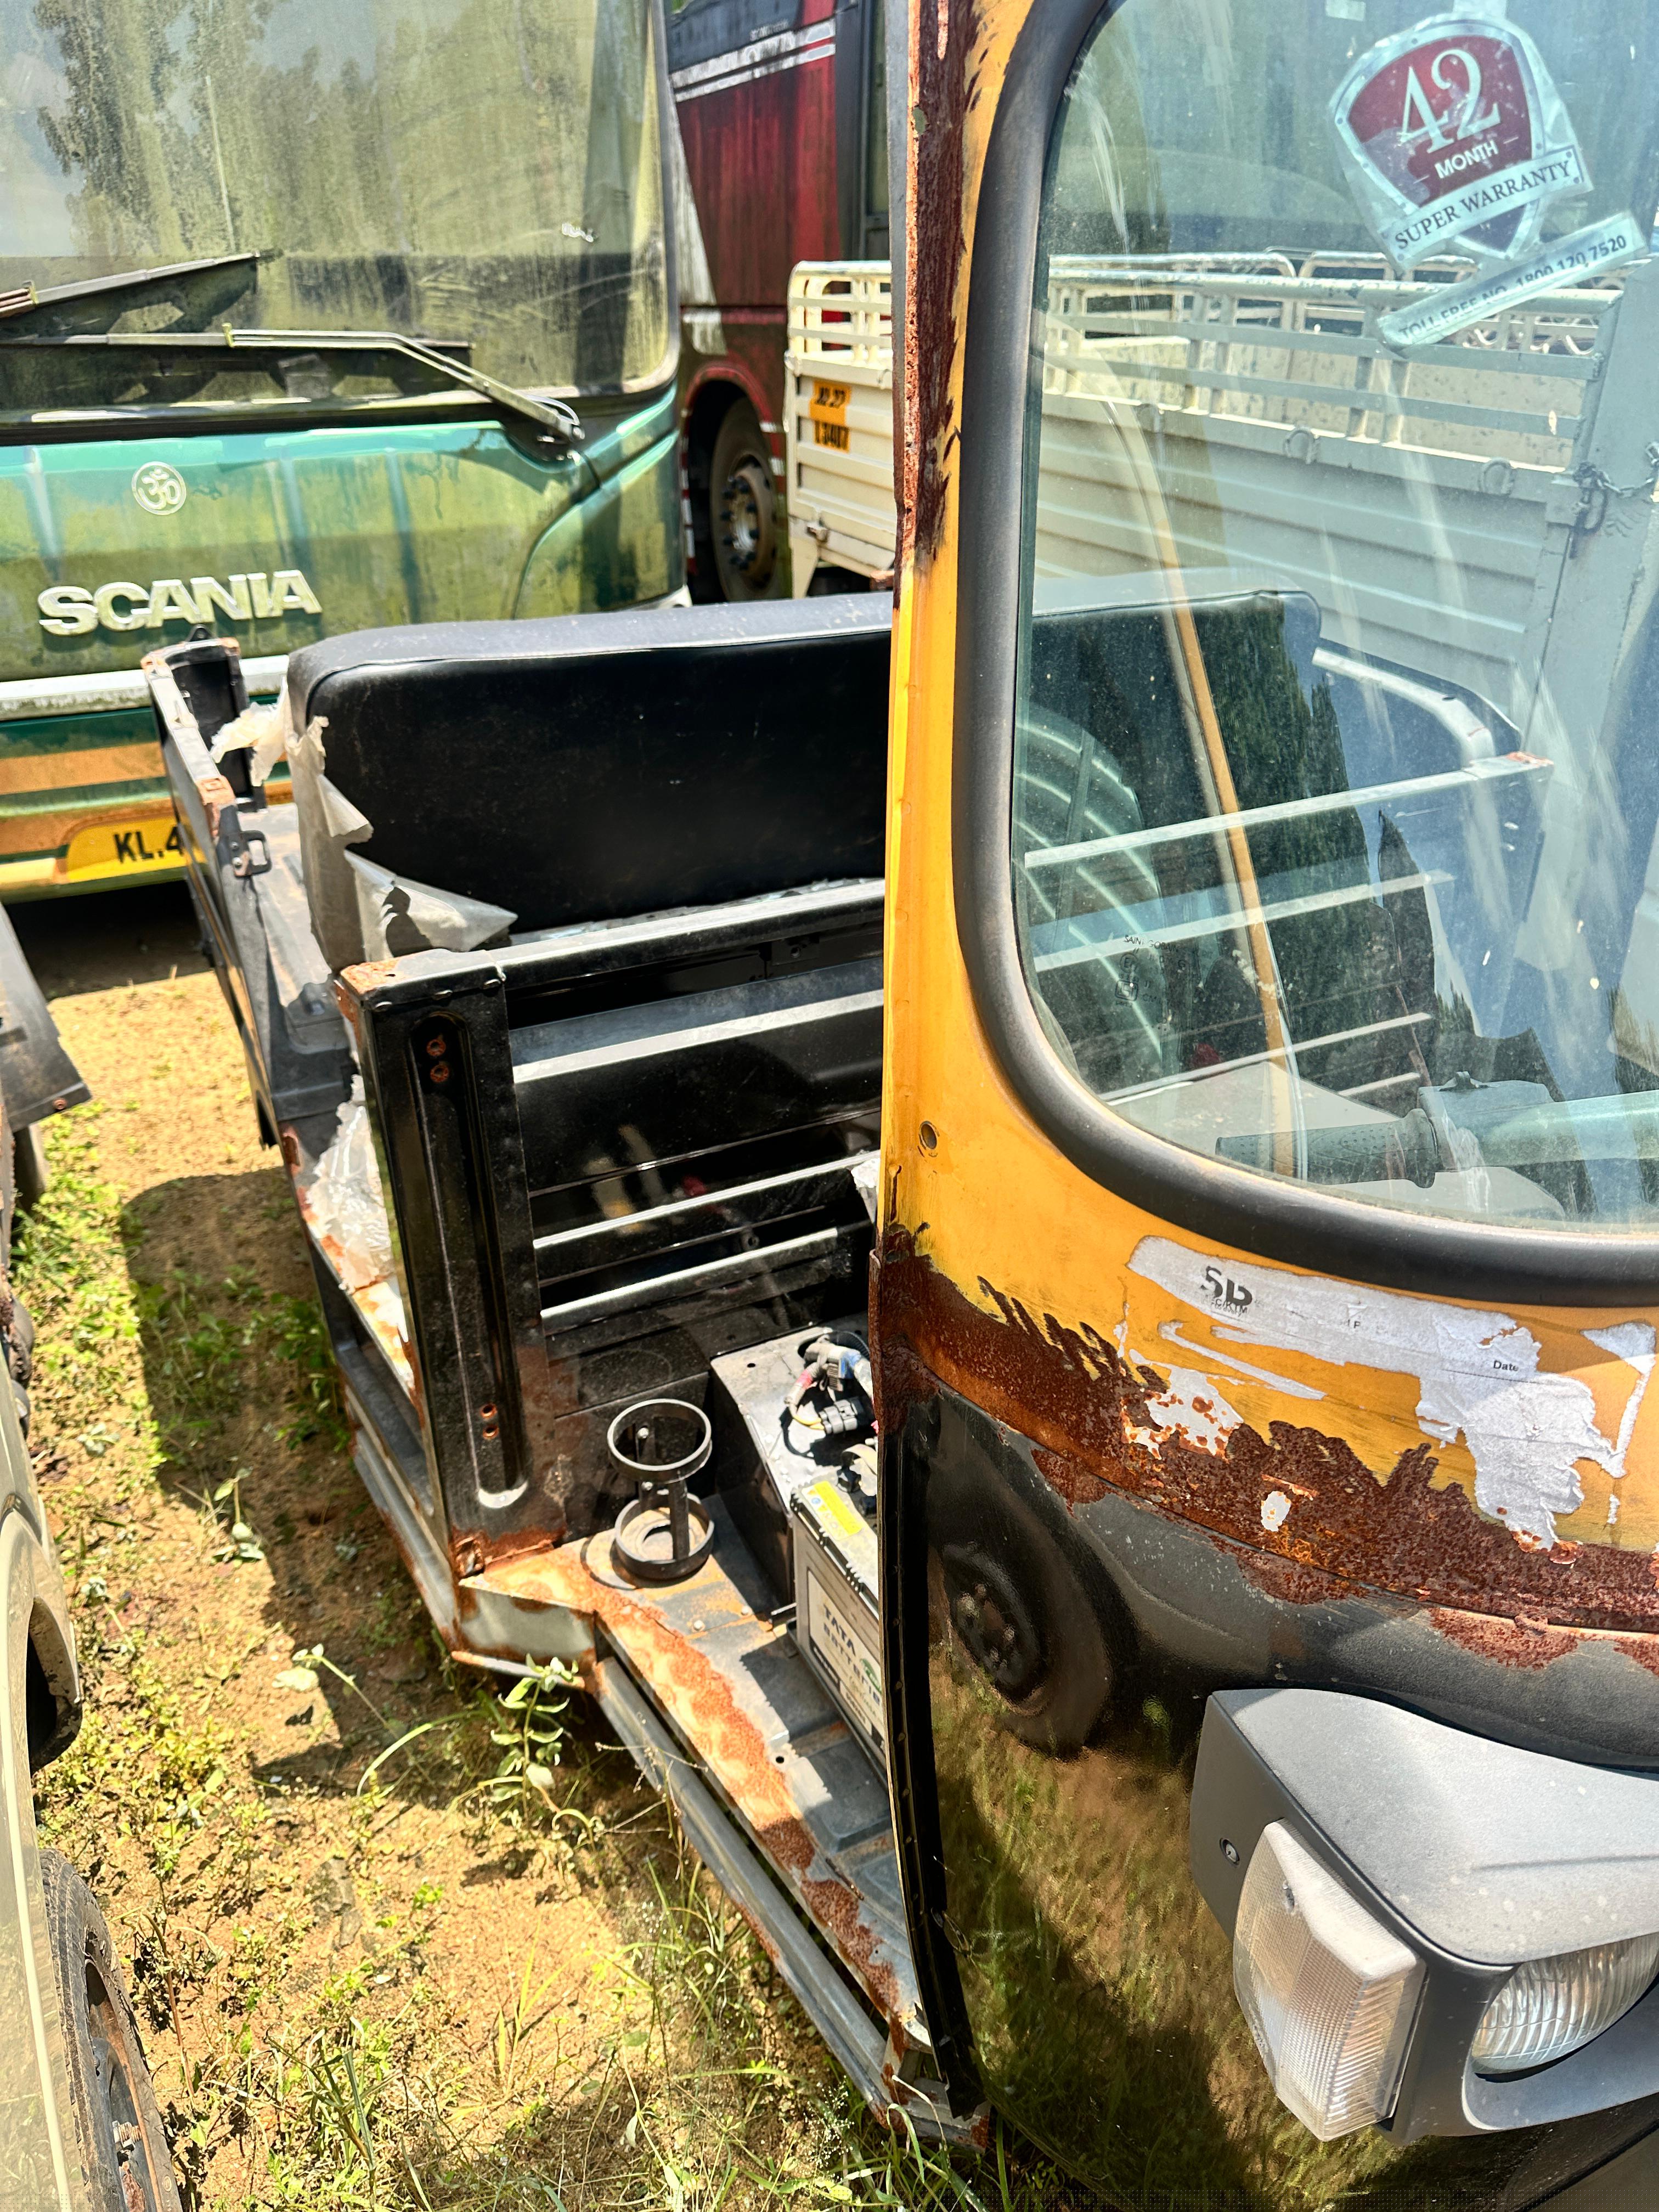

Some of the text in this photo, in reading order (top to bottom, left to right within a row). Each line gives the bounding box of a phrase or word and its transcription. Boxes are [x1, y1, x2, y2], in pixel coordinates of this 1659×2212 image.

[1400, 48, 1502, 154] 42
[1434, 139, 1498, 179] MONTH
[1395, 160, 1573, 250] SUPER WARRANTY
[1558, 251, 1586, 272] 120
[1590, 234, 1627, 261] 7520
[38, 569, 322, 636] SCANIA
[1493, 1359, 1519, 1372] Date
[823, 1604, 856, 1657] TATA
